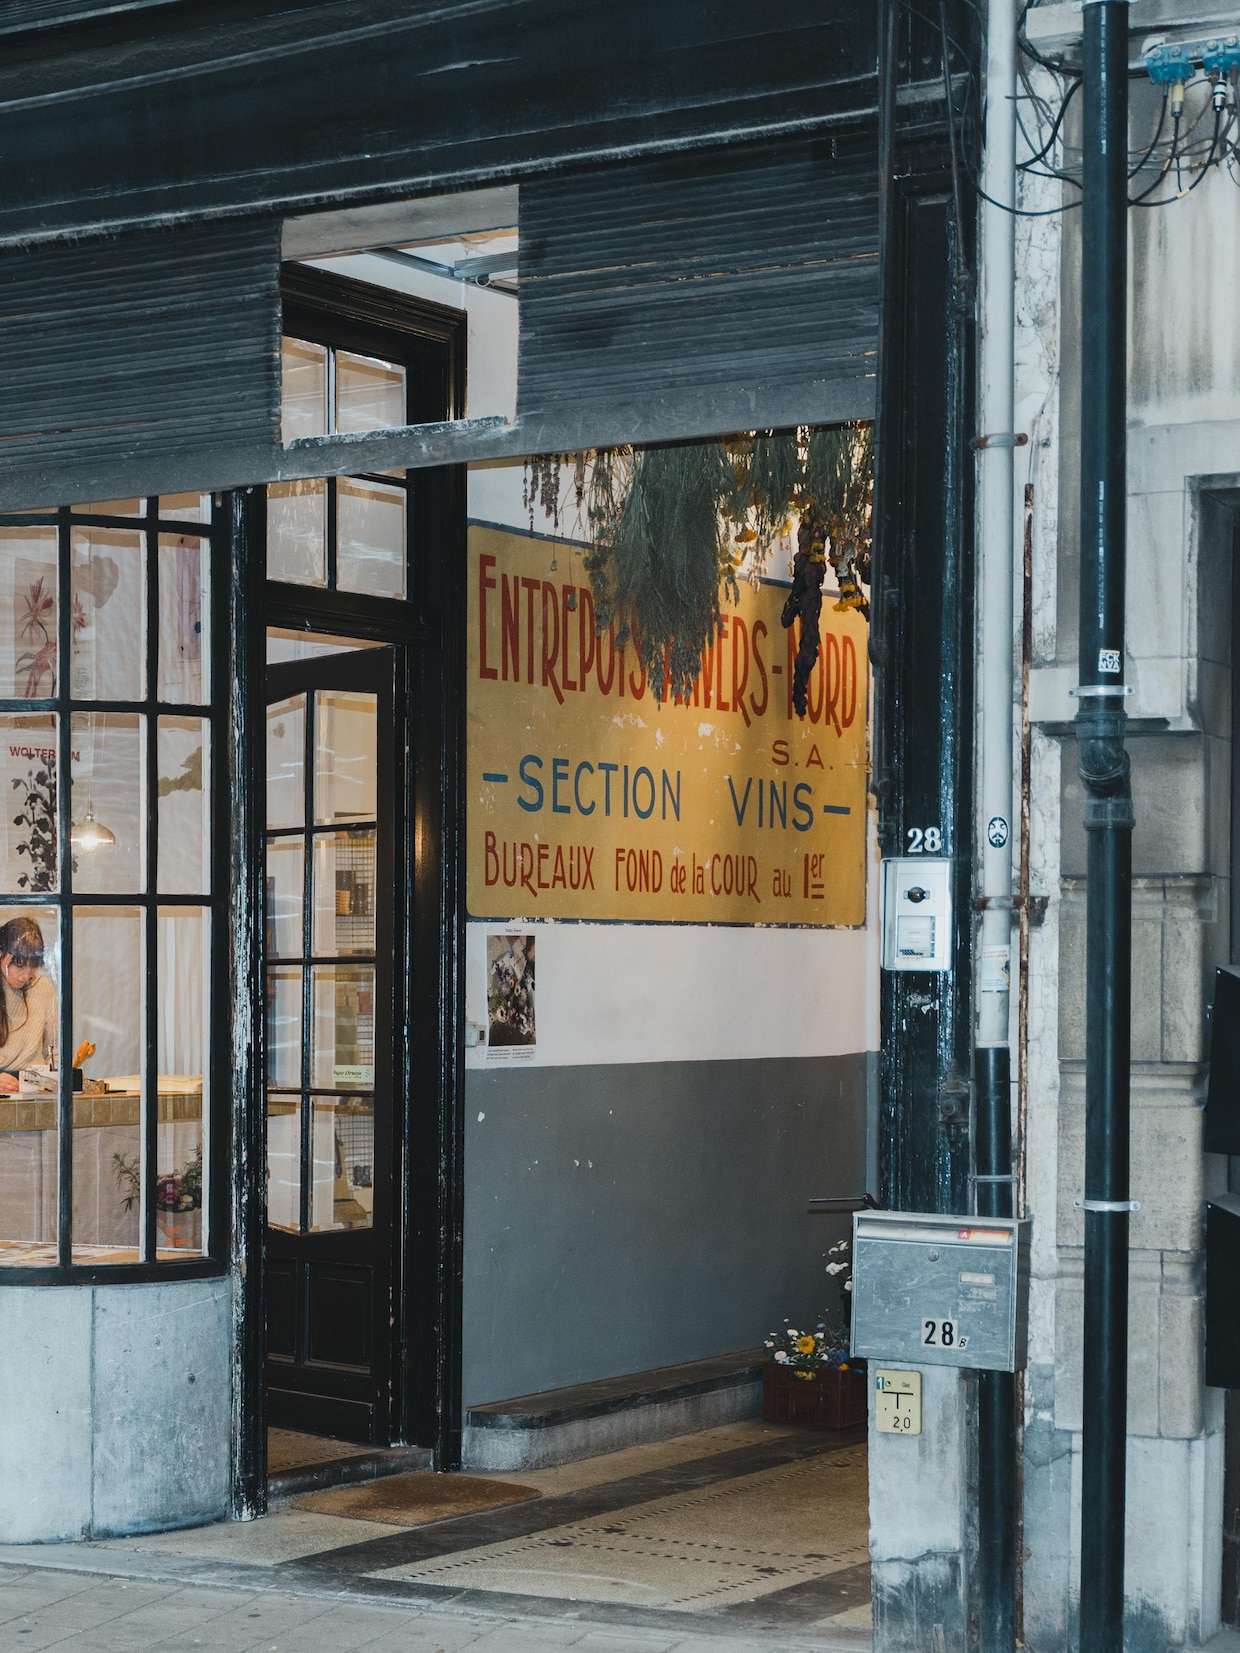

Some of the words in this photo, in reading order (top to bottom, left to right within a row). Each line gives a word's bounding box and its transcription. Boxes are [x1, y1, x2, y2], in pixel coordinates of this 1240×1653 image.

[1098, 660, 1121, 670] NVA
[1099, 653, 1120, 662] FCK
[771, 739, 834, 771] S.A.
[907, 826, 941, 853] 28
[484, 830, 596, 897] BUREAUX
[615, 848, 663, 893] FOND
[670, 856, 687, 894] de
[692, 852, 705, 895] la
[711, 853, 761, 904] COUR
[772, 868, 792, 898] au
[924, 1320, 954, 1346] 28
